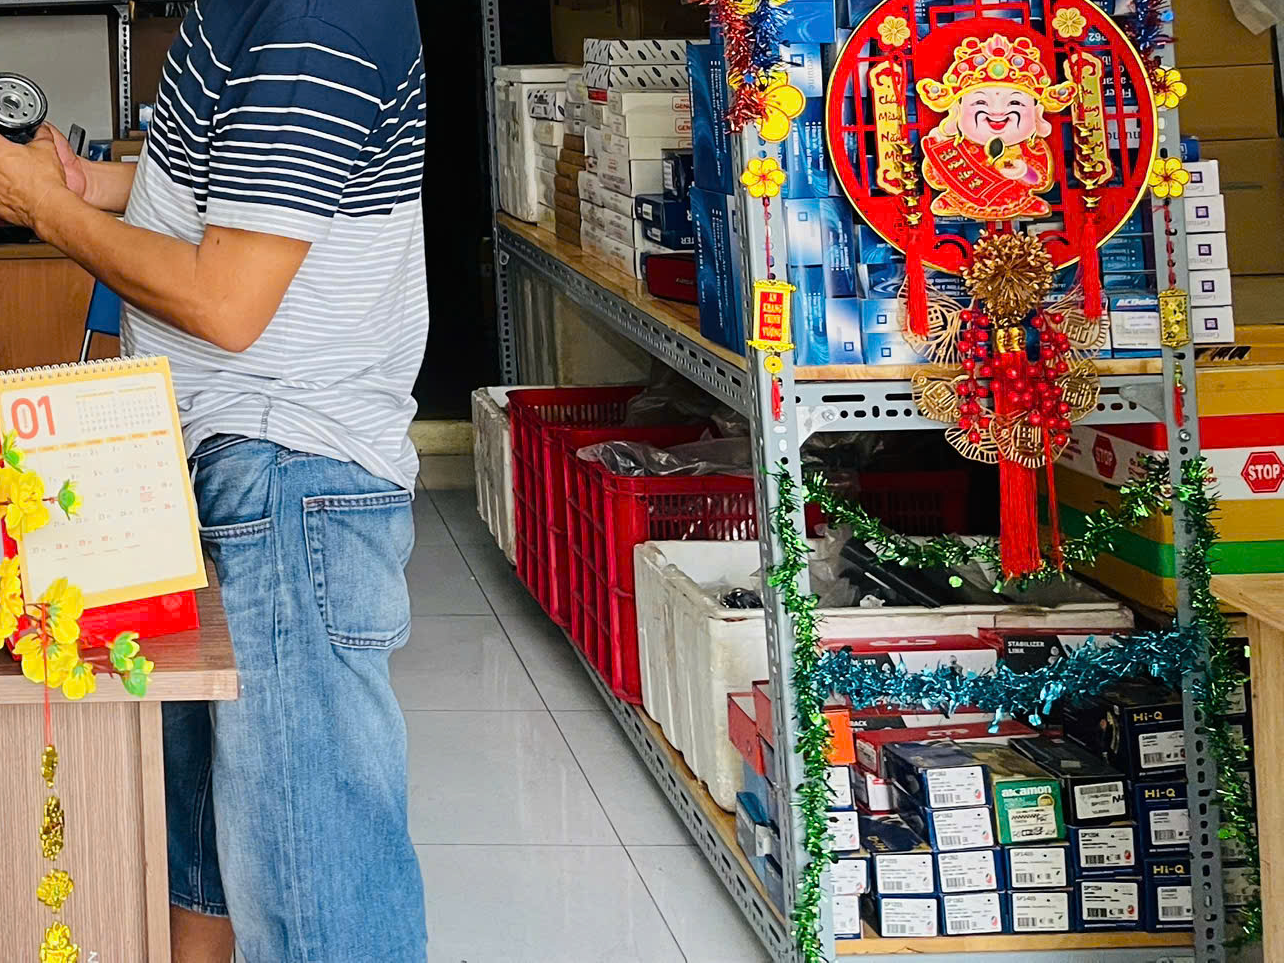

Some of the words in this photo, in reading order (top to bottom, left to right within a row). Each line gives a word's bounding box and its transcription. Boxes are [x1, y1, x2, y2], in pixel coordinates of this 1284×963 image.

[10, 395, 56, 440] 01
[1095, 446, 1114, 467] STOP
[1247, 464, 1281, 481] STOP
[1007, 640, 1045, 648] STABILIZER
[1133, 711, 1164, 721] Hi-Q
[1144, 788, 1176, 799] Hi-Q
[1152, 865, 1186, 875] Hi-Q
